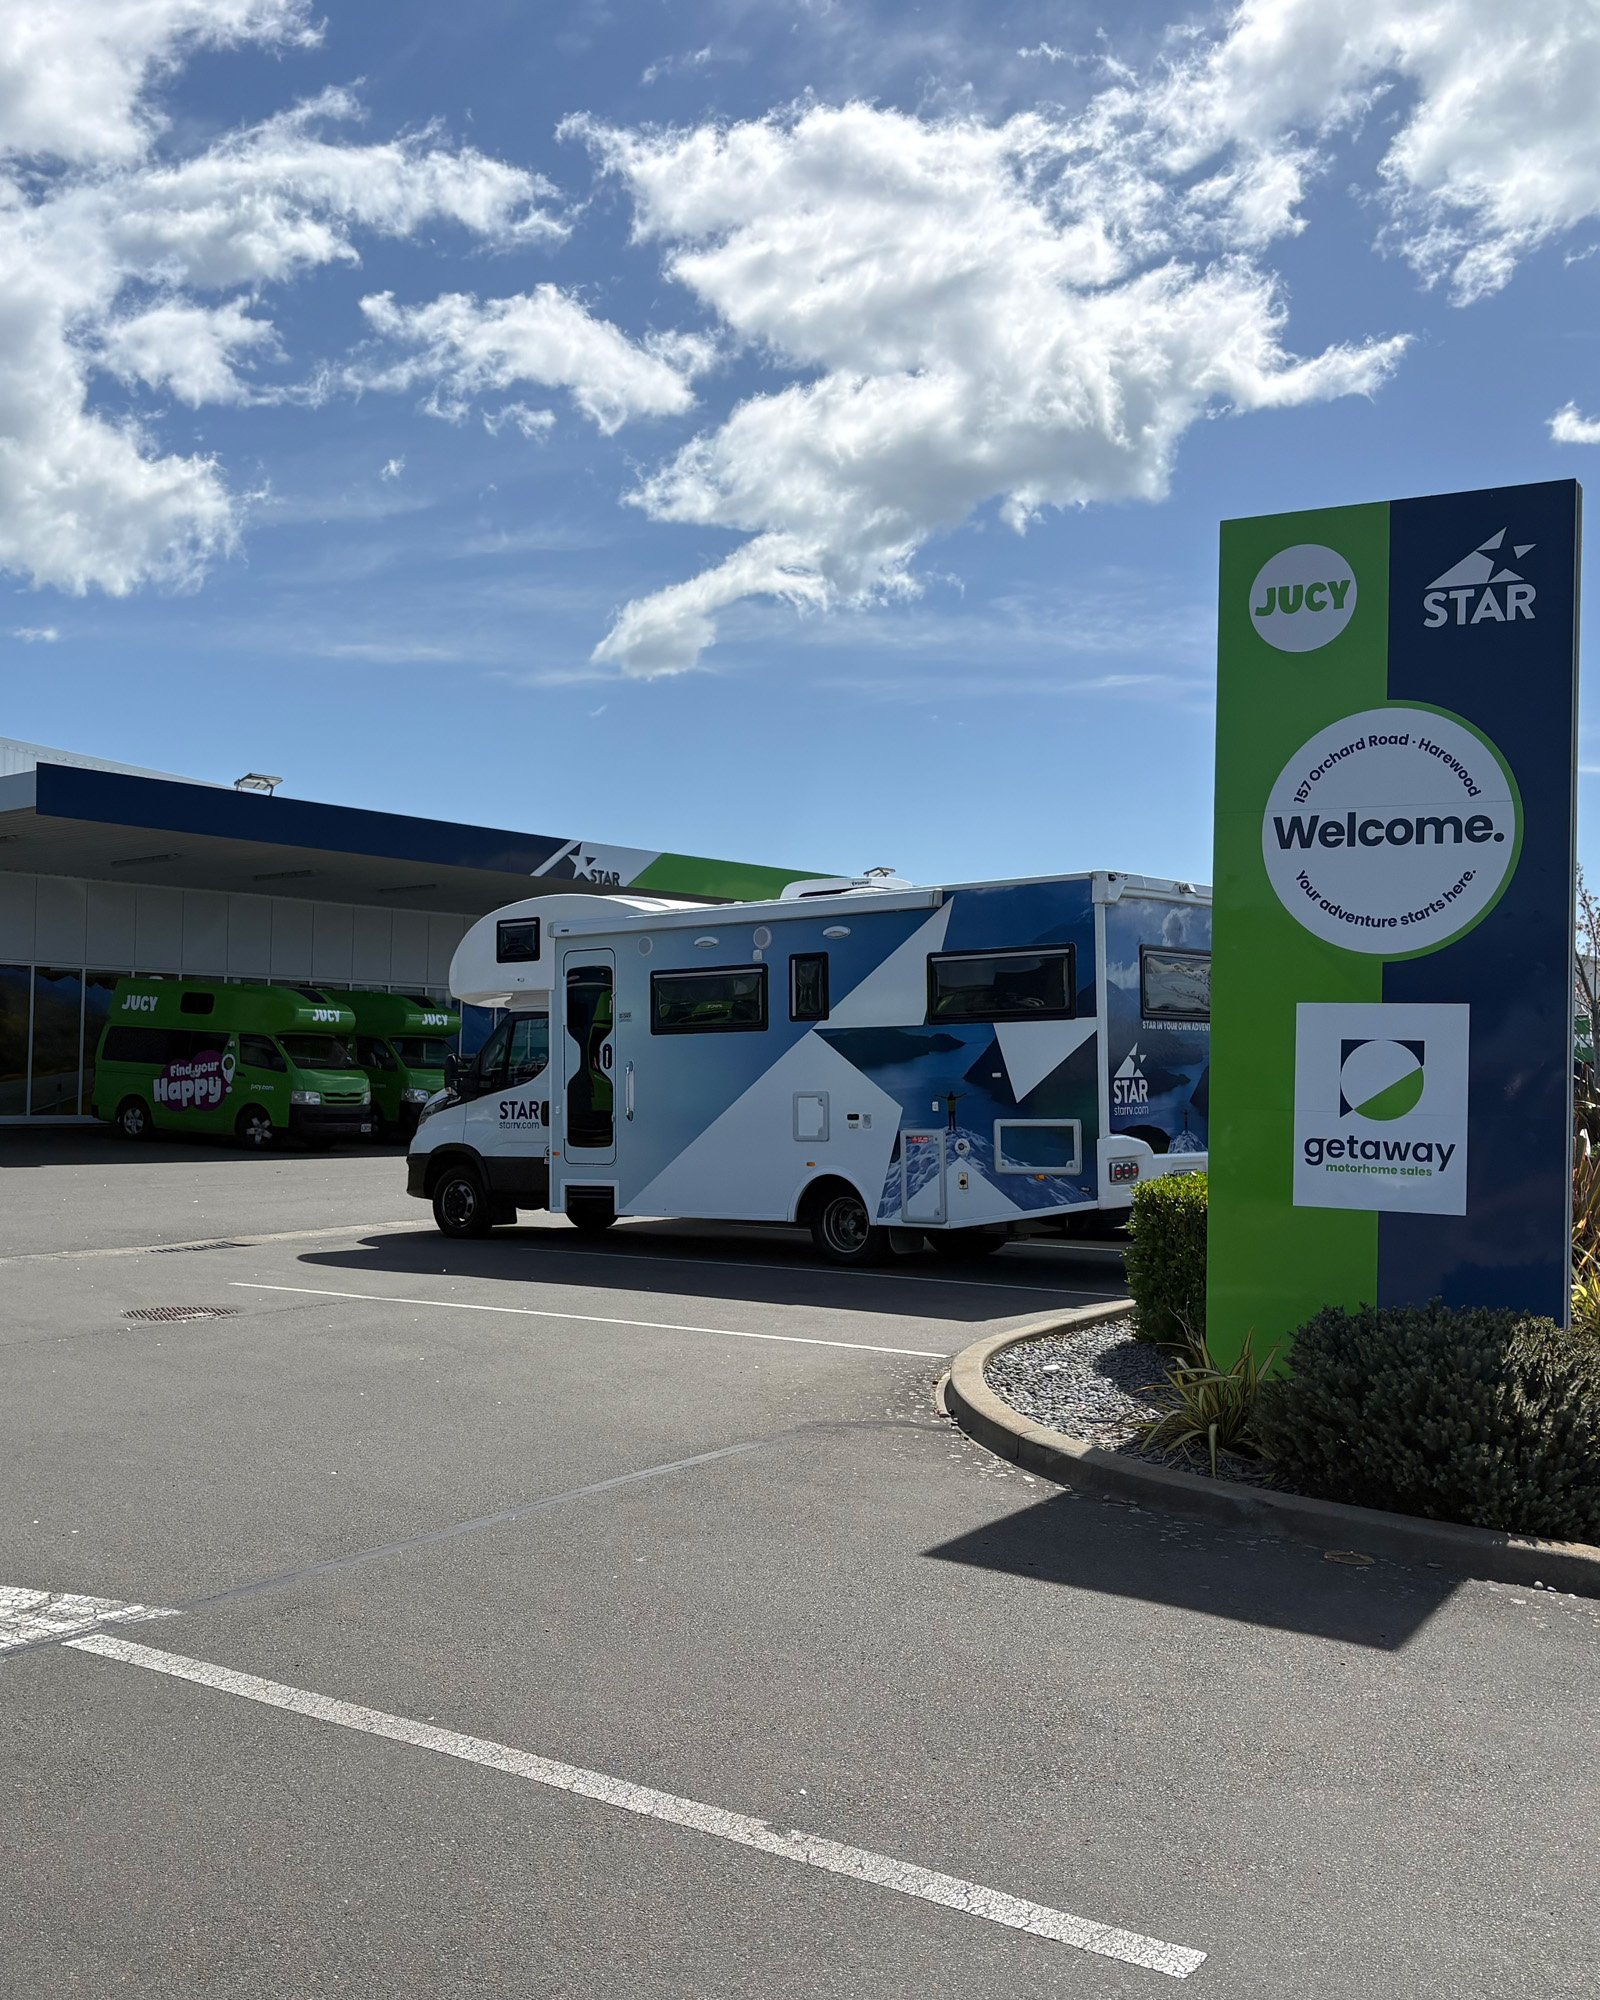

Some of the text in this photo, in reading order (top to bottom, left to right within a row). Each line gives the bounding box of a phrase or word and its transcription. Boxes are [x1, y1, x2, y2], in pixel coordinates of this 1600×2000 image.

[1255, 579, 1351, 617] JUCY
[1423, 583, 1537, 628] STAR
[1293, 733, 1482, 804] 157 Orchard Road Harewood
[1272, 811, 1505, 850] Welcome.
[590, 868, 620, 886] STAR
[1295, 868, 1477, 928] Your adventure starts here.
[121, 994, 159, 1012] JUCY
[312, 1009, 340, 1023] JUCY
[421, 1013, 448, 1026] JUCY
[1142, 1020, 1156, 1030] STAR
[1163, 1021, 1178, 1031] YOUR
[1178, 1022, 1191, 1031] OWN
[170, 1061, 219, 1077] Find your
[1113, 1079, 1149, 1104] STAR
[499, 1100, 539, 1120] STAR
[1113, 1106, 1149, 1116] starrv.com
[499, 1121, 540, 1129] starrv.com
[1304, 1135, 1456, 1172] getaway
[1325, 1163, 1432, 1177] motorhome sales
